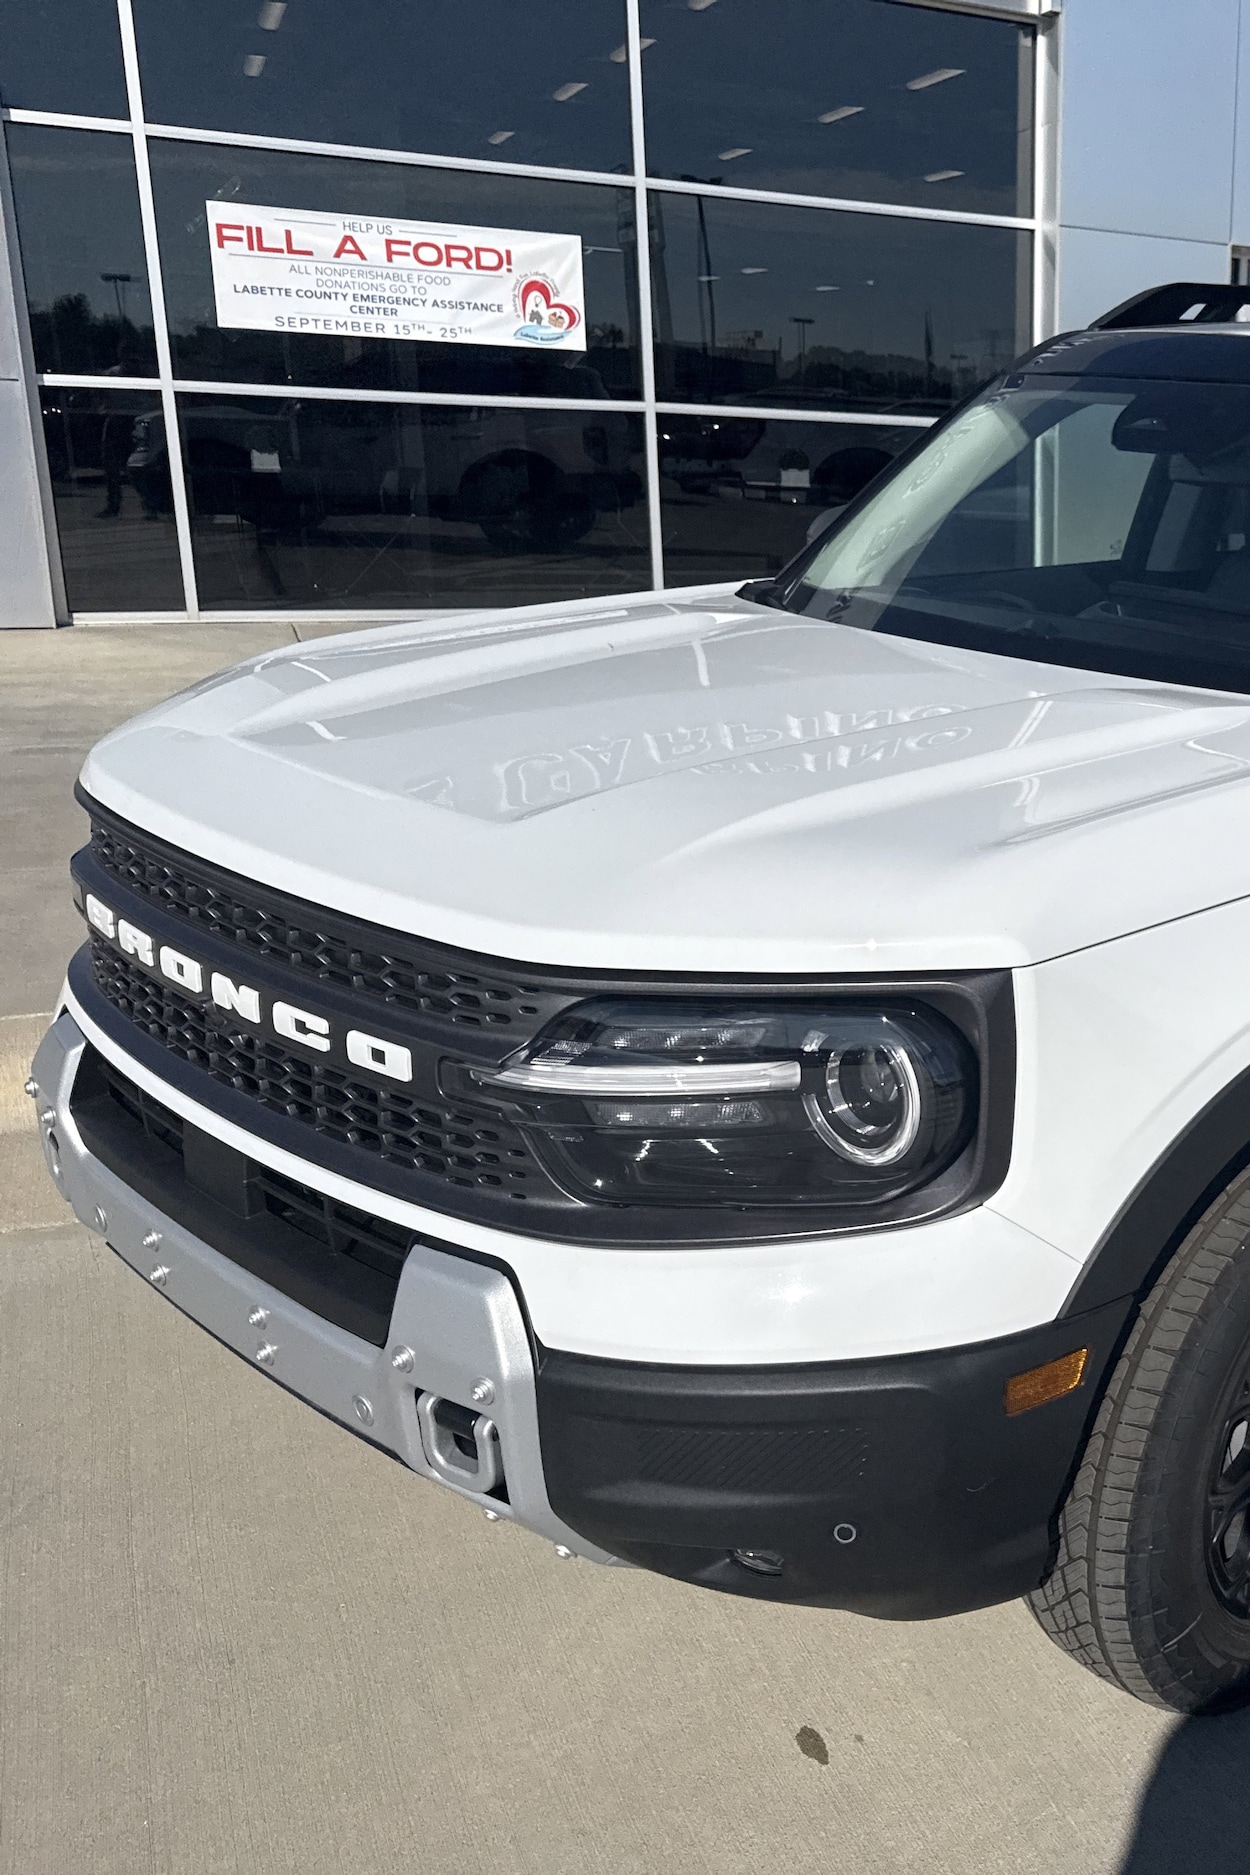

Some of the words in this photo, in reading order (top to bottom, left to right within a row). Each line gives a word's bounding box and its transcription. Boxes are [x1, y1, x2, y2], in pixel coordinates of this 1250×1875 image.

[343, 221, 373, 233] HELP
[377, 223, 393, 235] US
[215, 223, 314, 256] FILL
[333, 235, 368, 261] A
[385, 238, 512, 273] FORD!
[289, 264, 313, 275] ALL
[315, 266, 413, 283] NONPERISHABLE
[417, 274, 452, 286] FOOD
[316, 278, 386, 293] DONATIONS
[389, 284, 407, 294] GO
[411, 285, 427, 296] TO
[233, 284, 292, 297] LABETTE
[295, 289, 348, 301] COUNTY
[352, 293, 427, 307] EMERGENCY
[431, 299, 504, 313] ASSISTANCE
[349, 305, 398, 317] CENTER
[274, 316, 386, 334] SEPTEMBER
[440, 326, 472, 338] 25TH
[86, 893, 412, 1082] BRONCO
